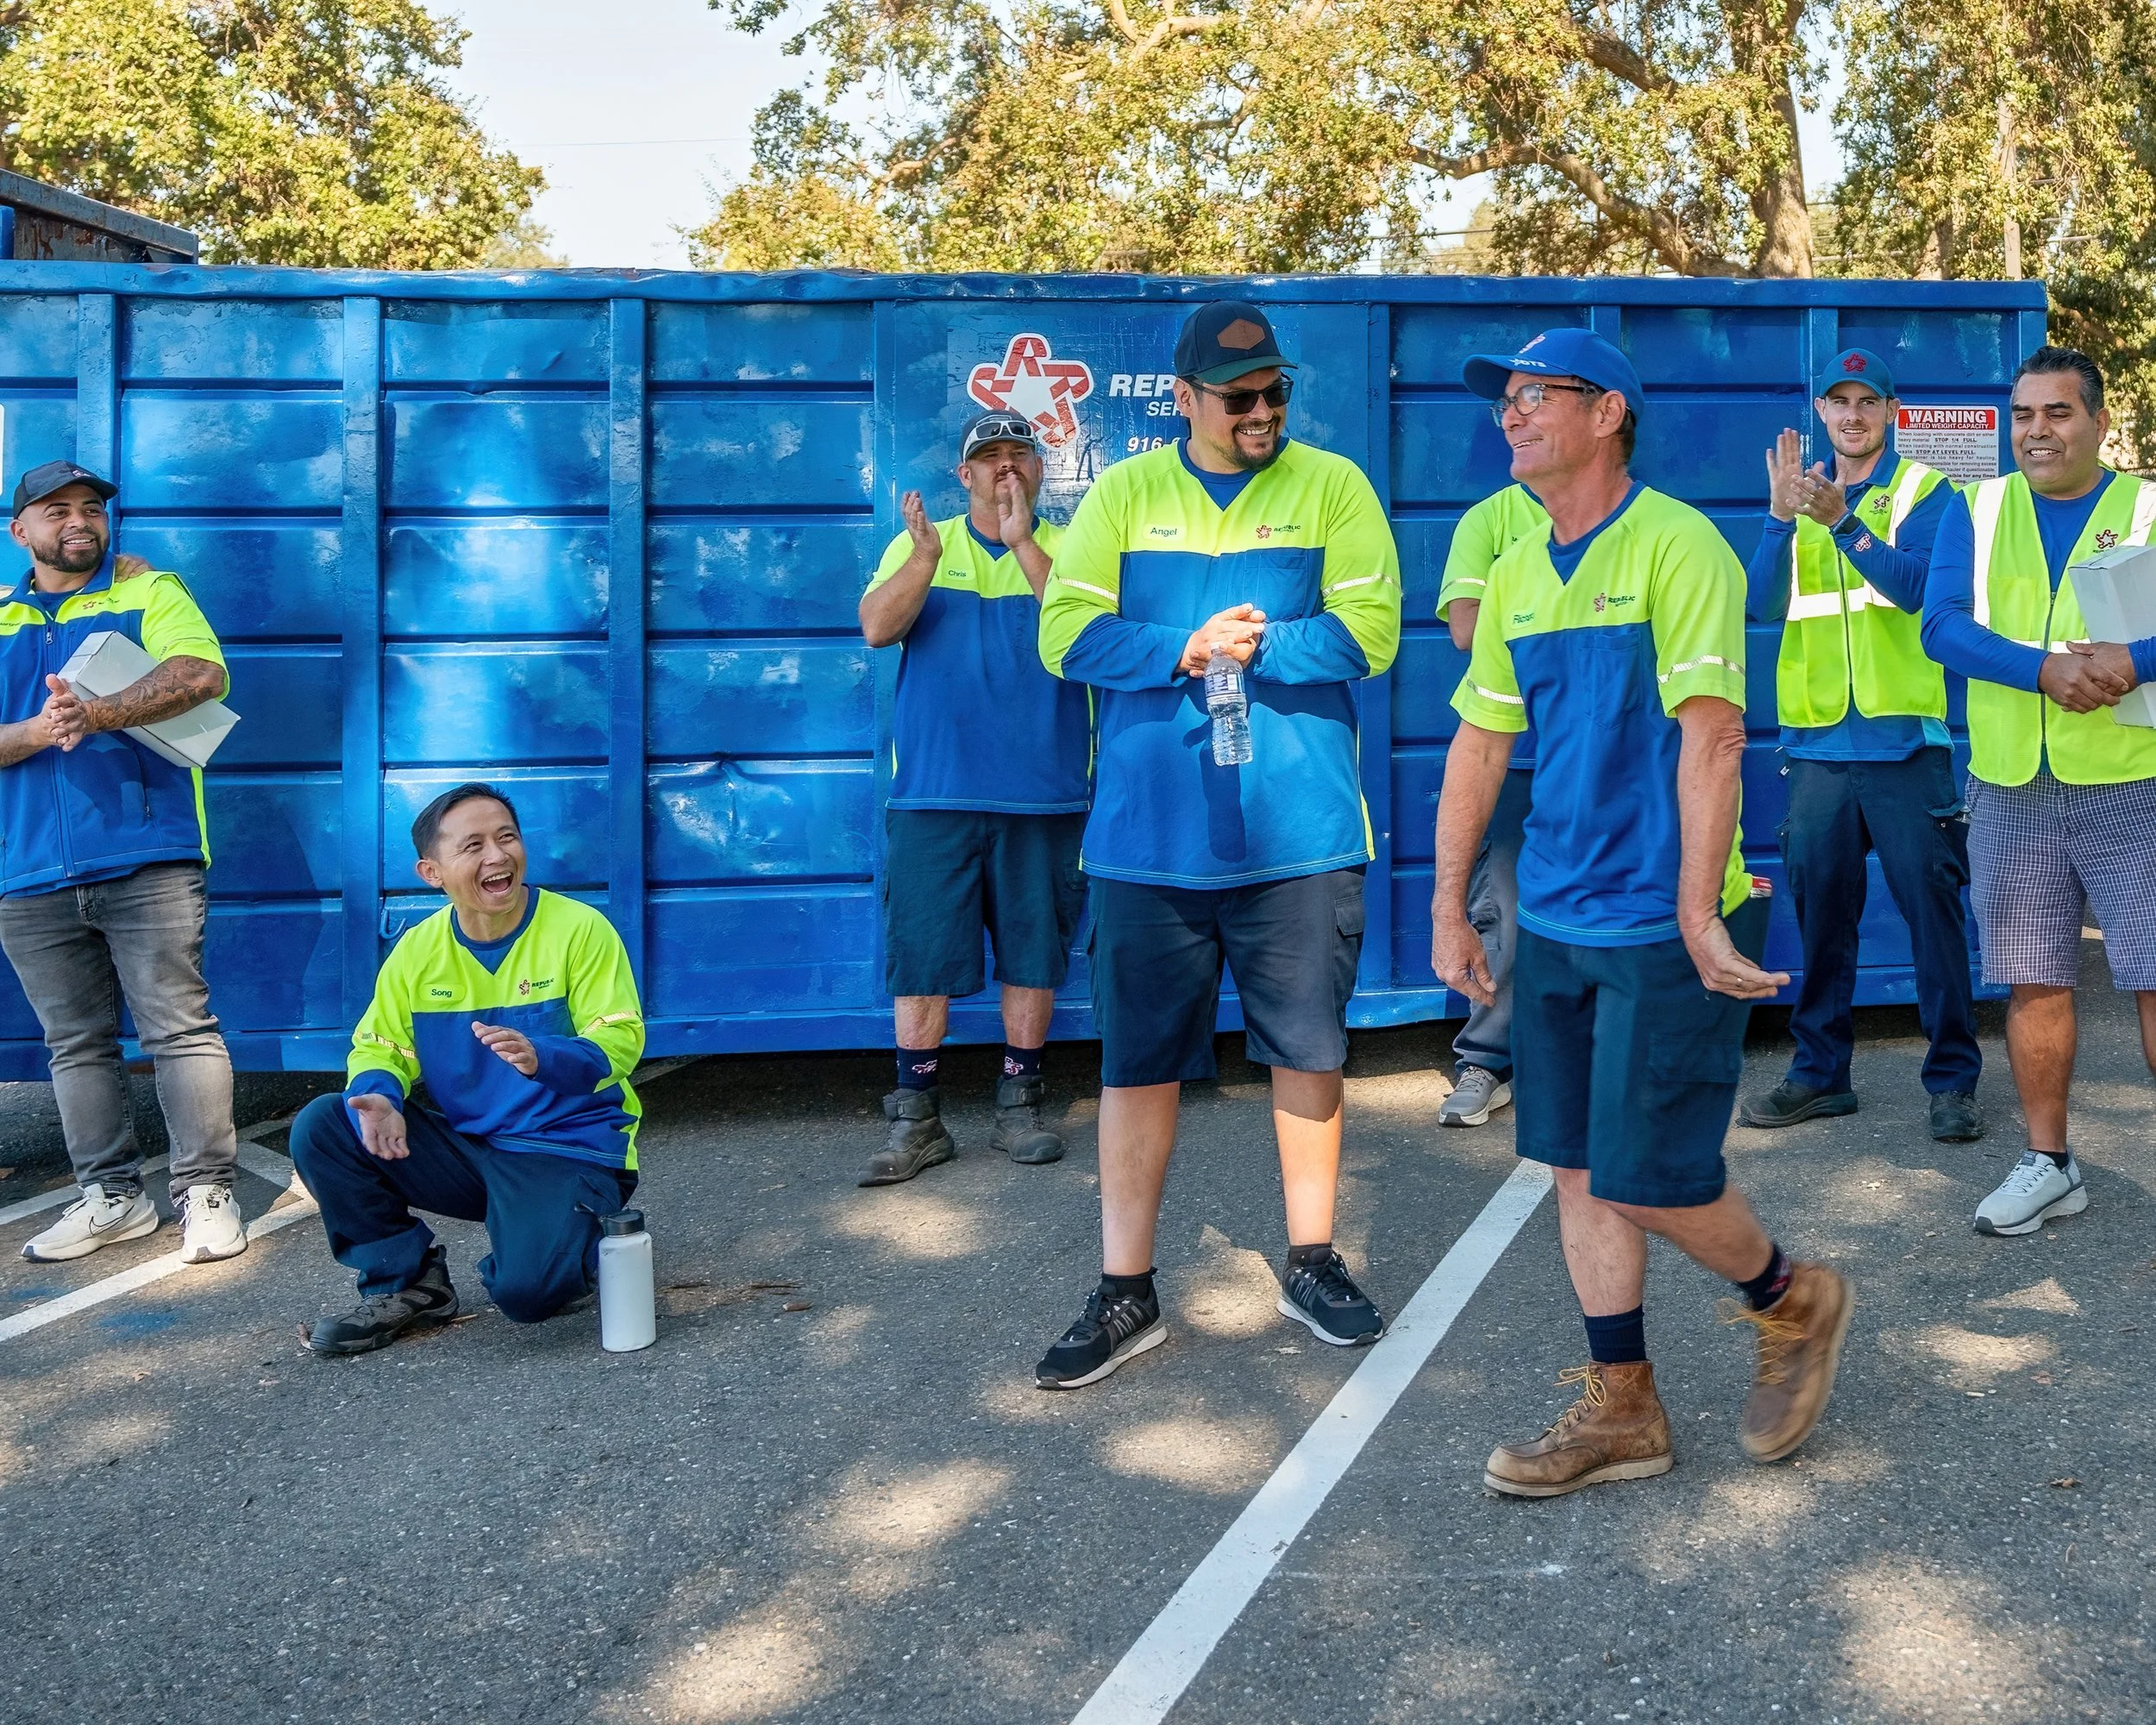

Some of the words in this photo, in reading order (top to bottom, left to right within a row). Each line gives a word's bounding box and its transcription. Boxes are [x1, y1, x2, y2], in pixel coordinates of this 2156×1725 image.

[1109, 374, 1177, 397] REP
[1907, 410, 1987, 423] WARNING
[1150, 527, 1178, 537] Angel
[431, 988, 453, 998] Song
